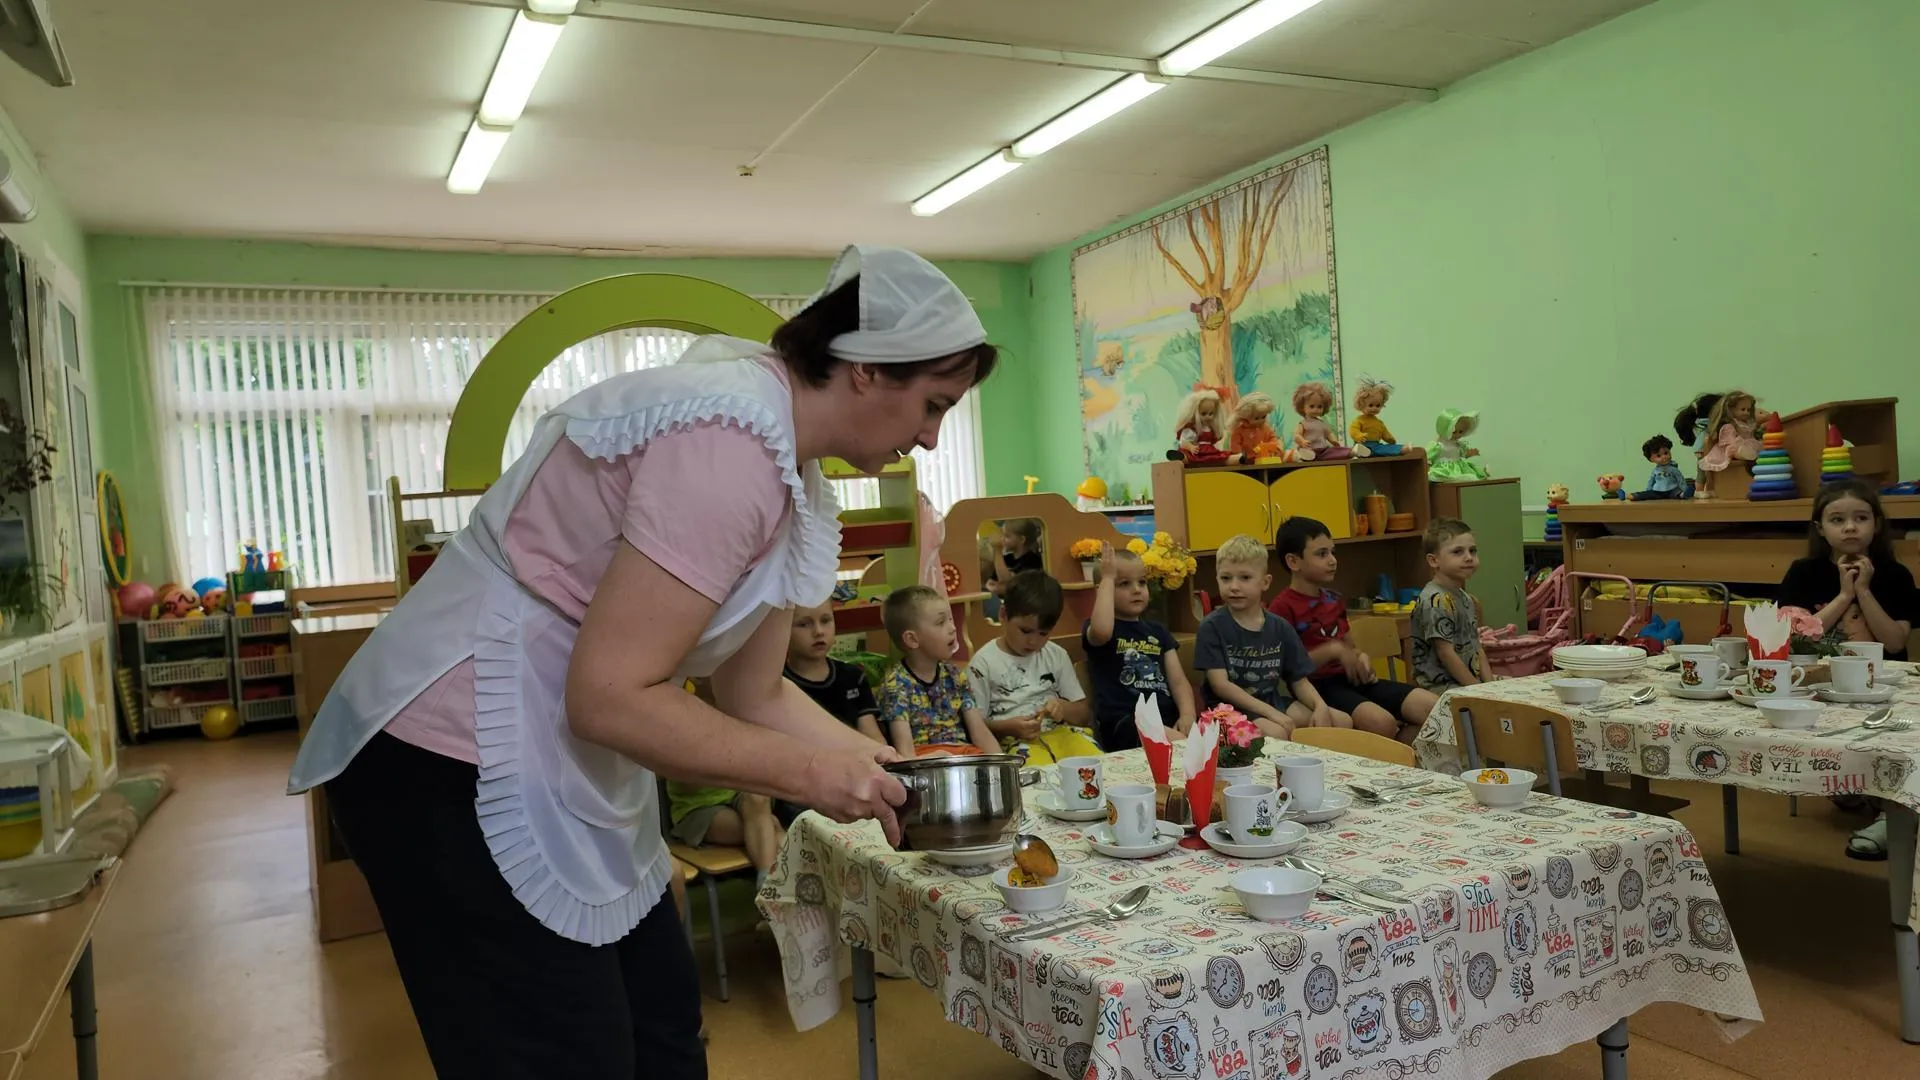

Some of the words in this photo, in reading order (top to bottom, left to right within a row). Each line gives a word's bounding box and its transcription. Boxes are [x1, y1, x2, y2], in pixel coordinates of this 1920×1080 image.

[1503, 720, 1511, 732] 2
[1462, 882, 1495, 910] Tea
[1468, 899, 1502, 933] TIME
[1623, 939, 1645, 958] tea
[1520, 962, 1534, 1003] tea
[1051, 1005, 1084, 1026] tea
[1315, 1027, 1342, 1048] herbal
[1028, 1046, 1058, 1069] TEA
[1209, 1049, 1249, 1079] tea
[1314, 1047, 1343, 1071] tea
